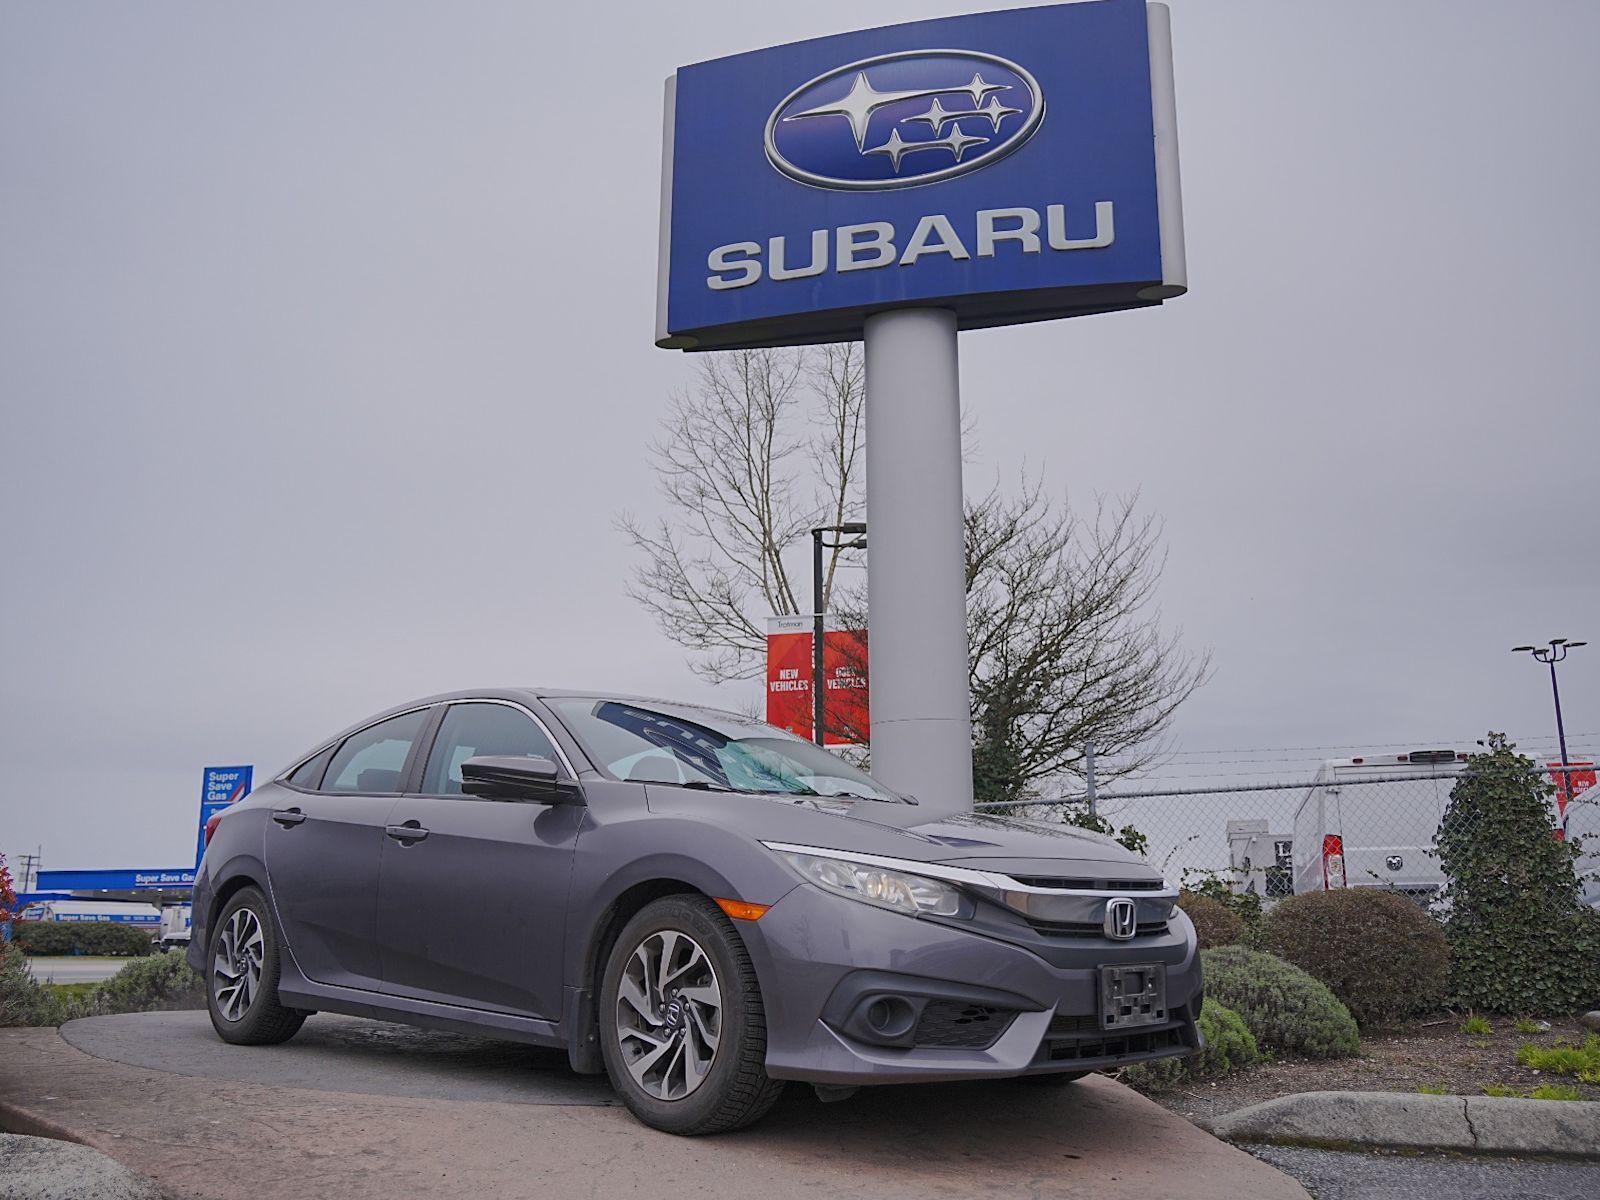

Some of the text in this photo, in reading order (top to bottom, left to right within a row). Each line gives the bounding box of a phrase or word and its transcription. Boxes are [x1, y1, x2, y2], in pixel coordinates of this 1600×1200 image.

[707, 200, 1115, 291] SUBARU
[780, 669, 799, 680] NEW
[770, 680, 809, 692] VEHICLES
[209, 771, 239, 783] Super
[208, 781, 232, 791] Save
[207, 791, 227, 801] Gas
[135, 874, 159, 885] Super
[160, 873, 180, 882] Save
